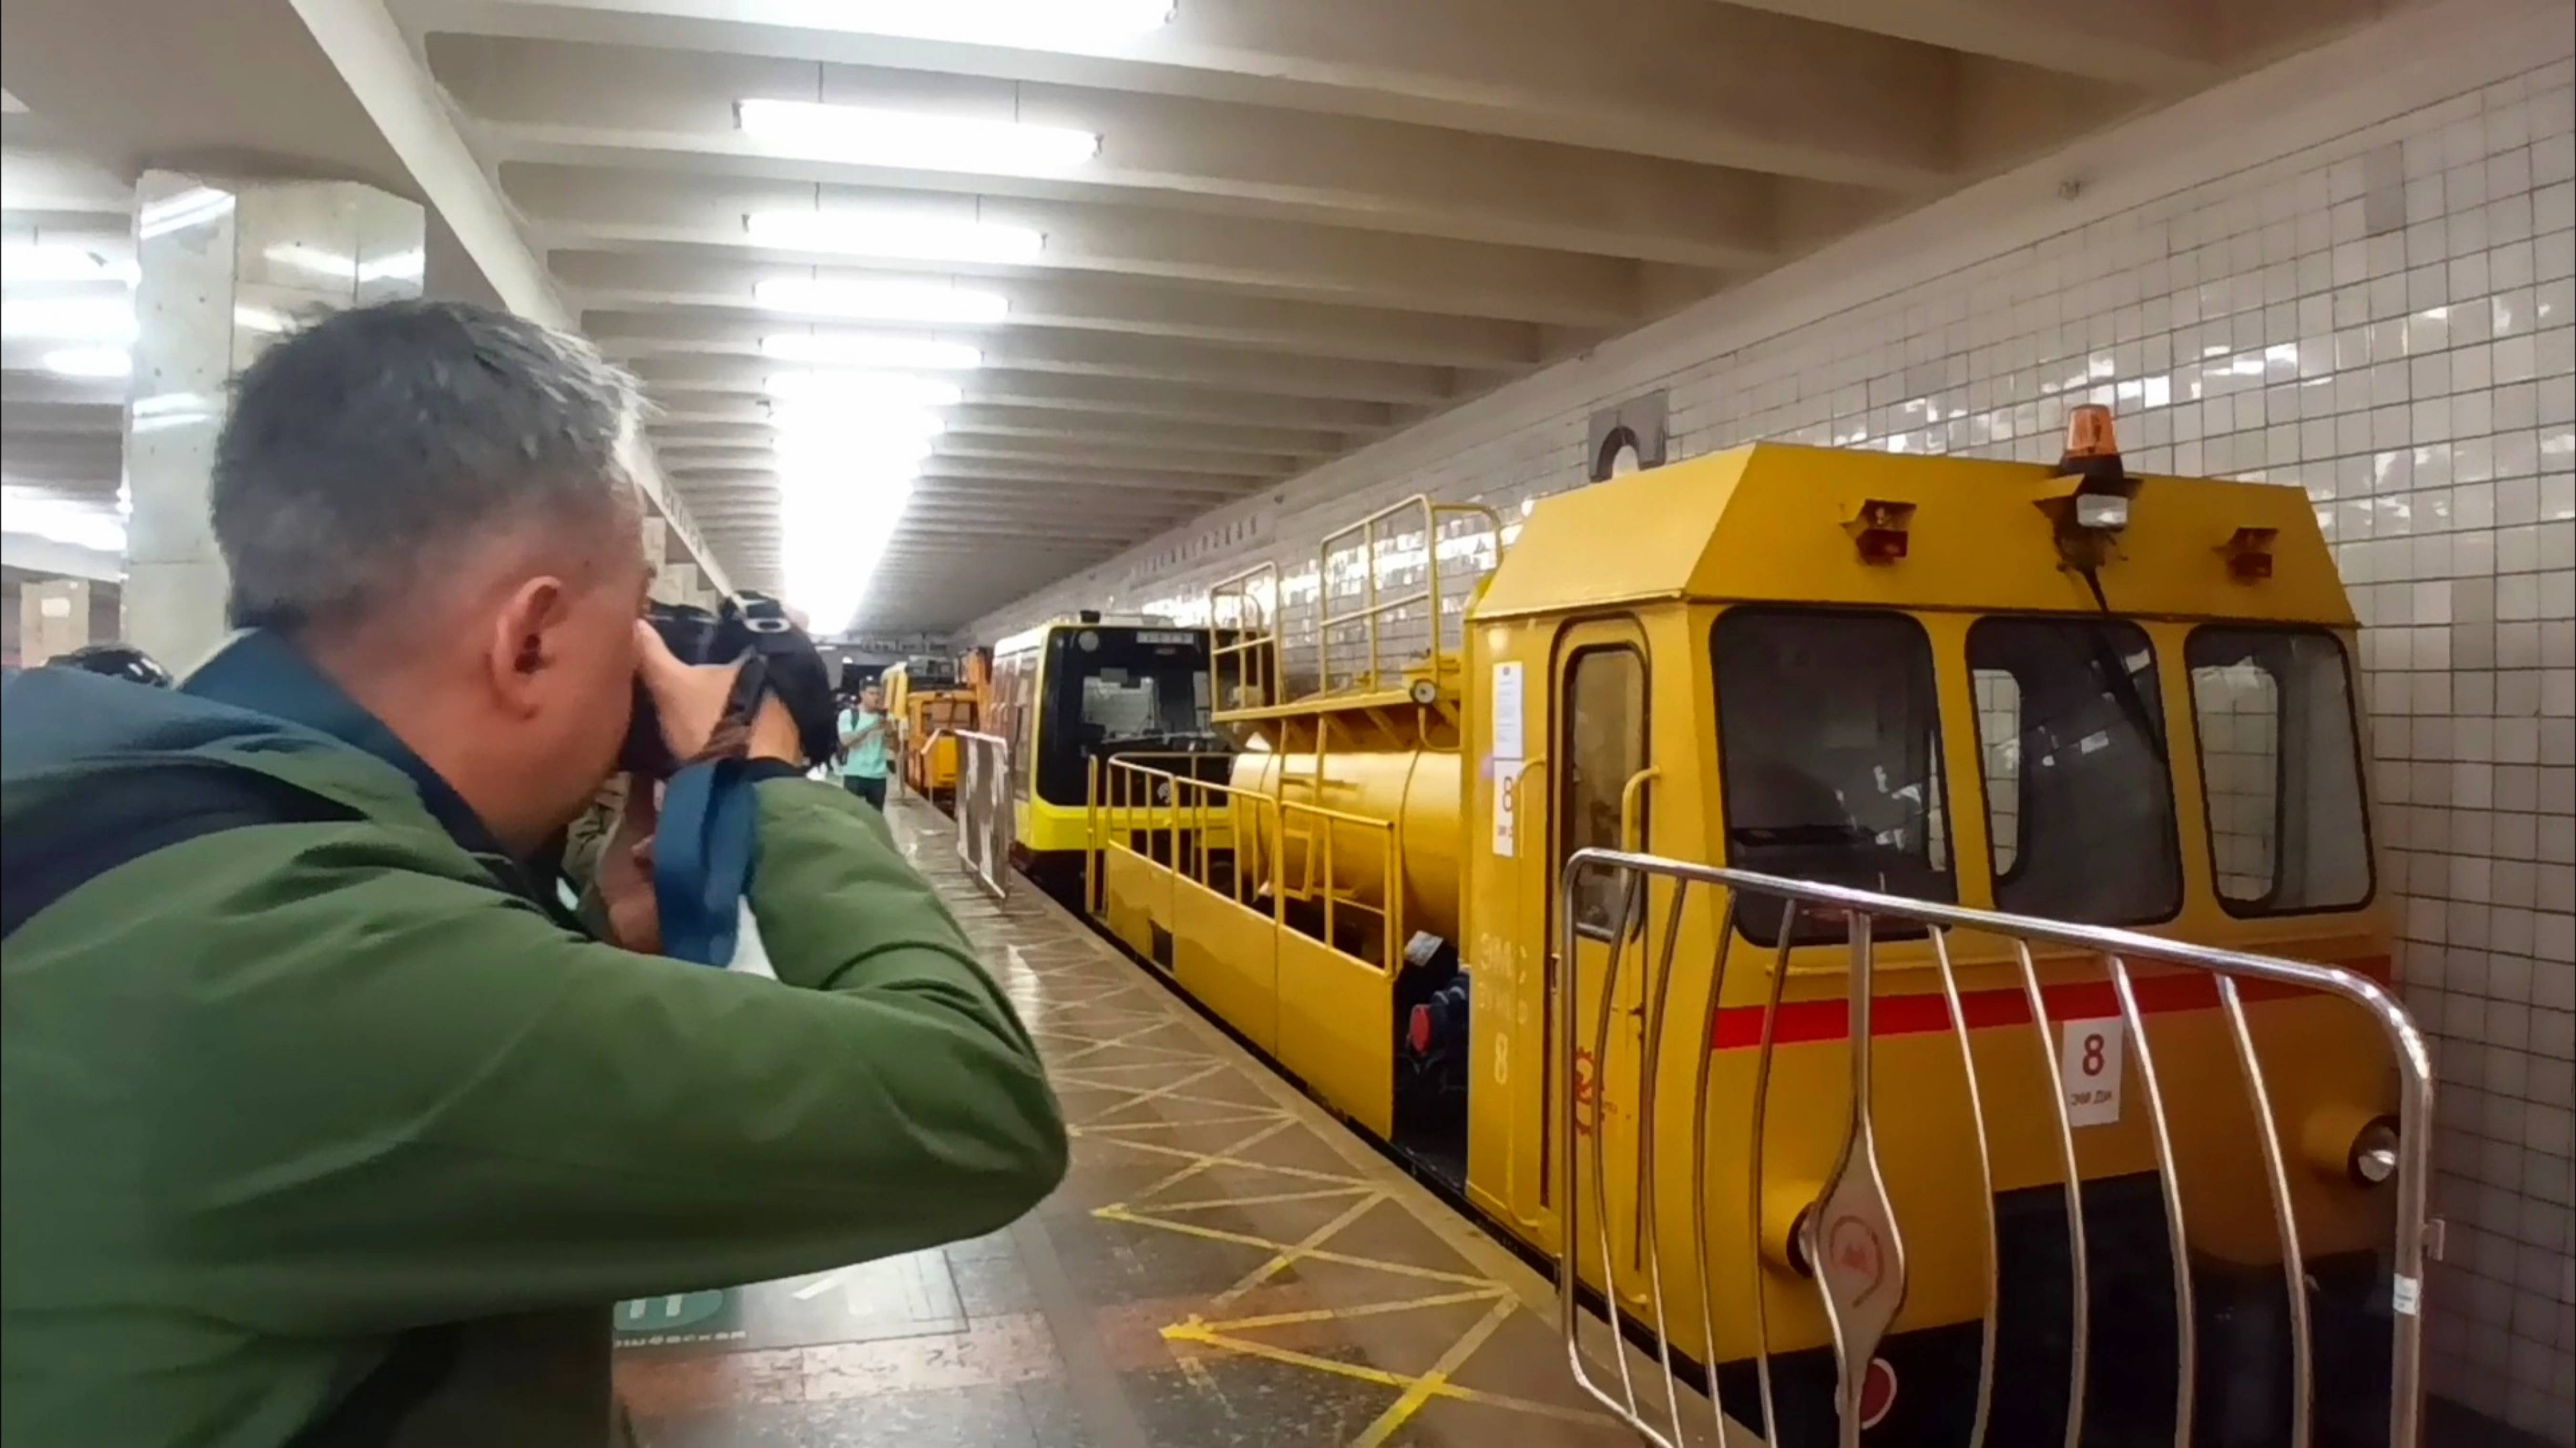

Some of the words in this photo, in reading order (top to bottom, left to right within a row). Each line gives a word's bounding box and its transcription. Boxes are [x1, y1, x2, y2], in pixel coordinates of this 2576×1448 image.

[1502, 776, 1513, 812] 8
[1494, 1032, 1508, 1085] 8
[2082, 1033, 2105, 1076] 8
